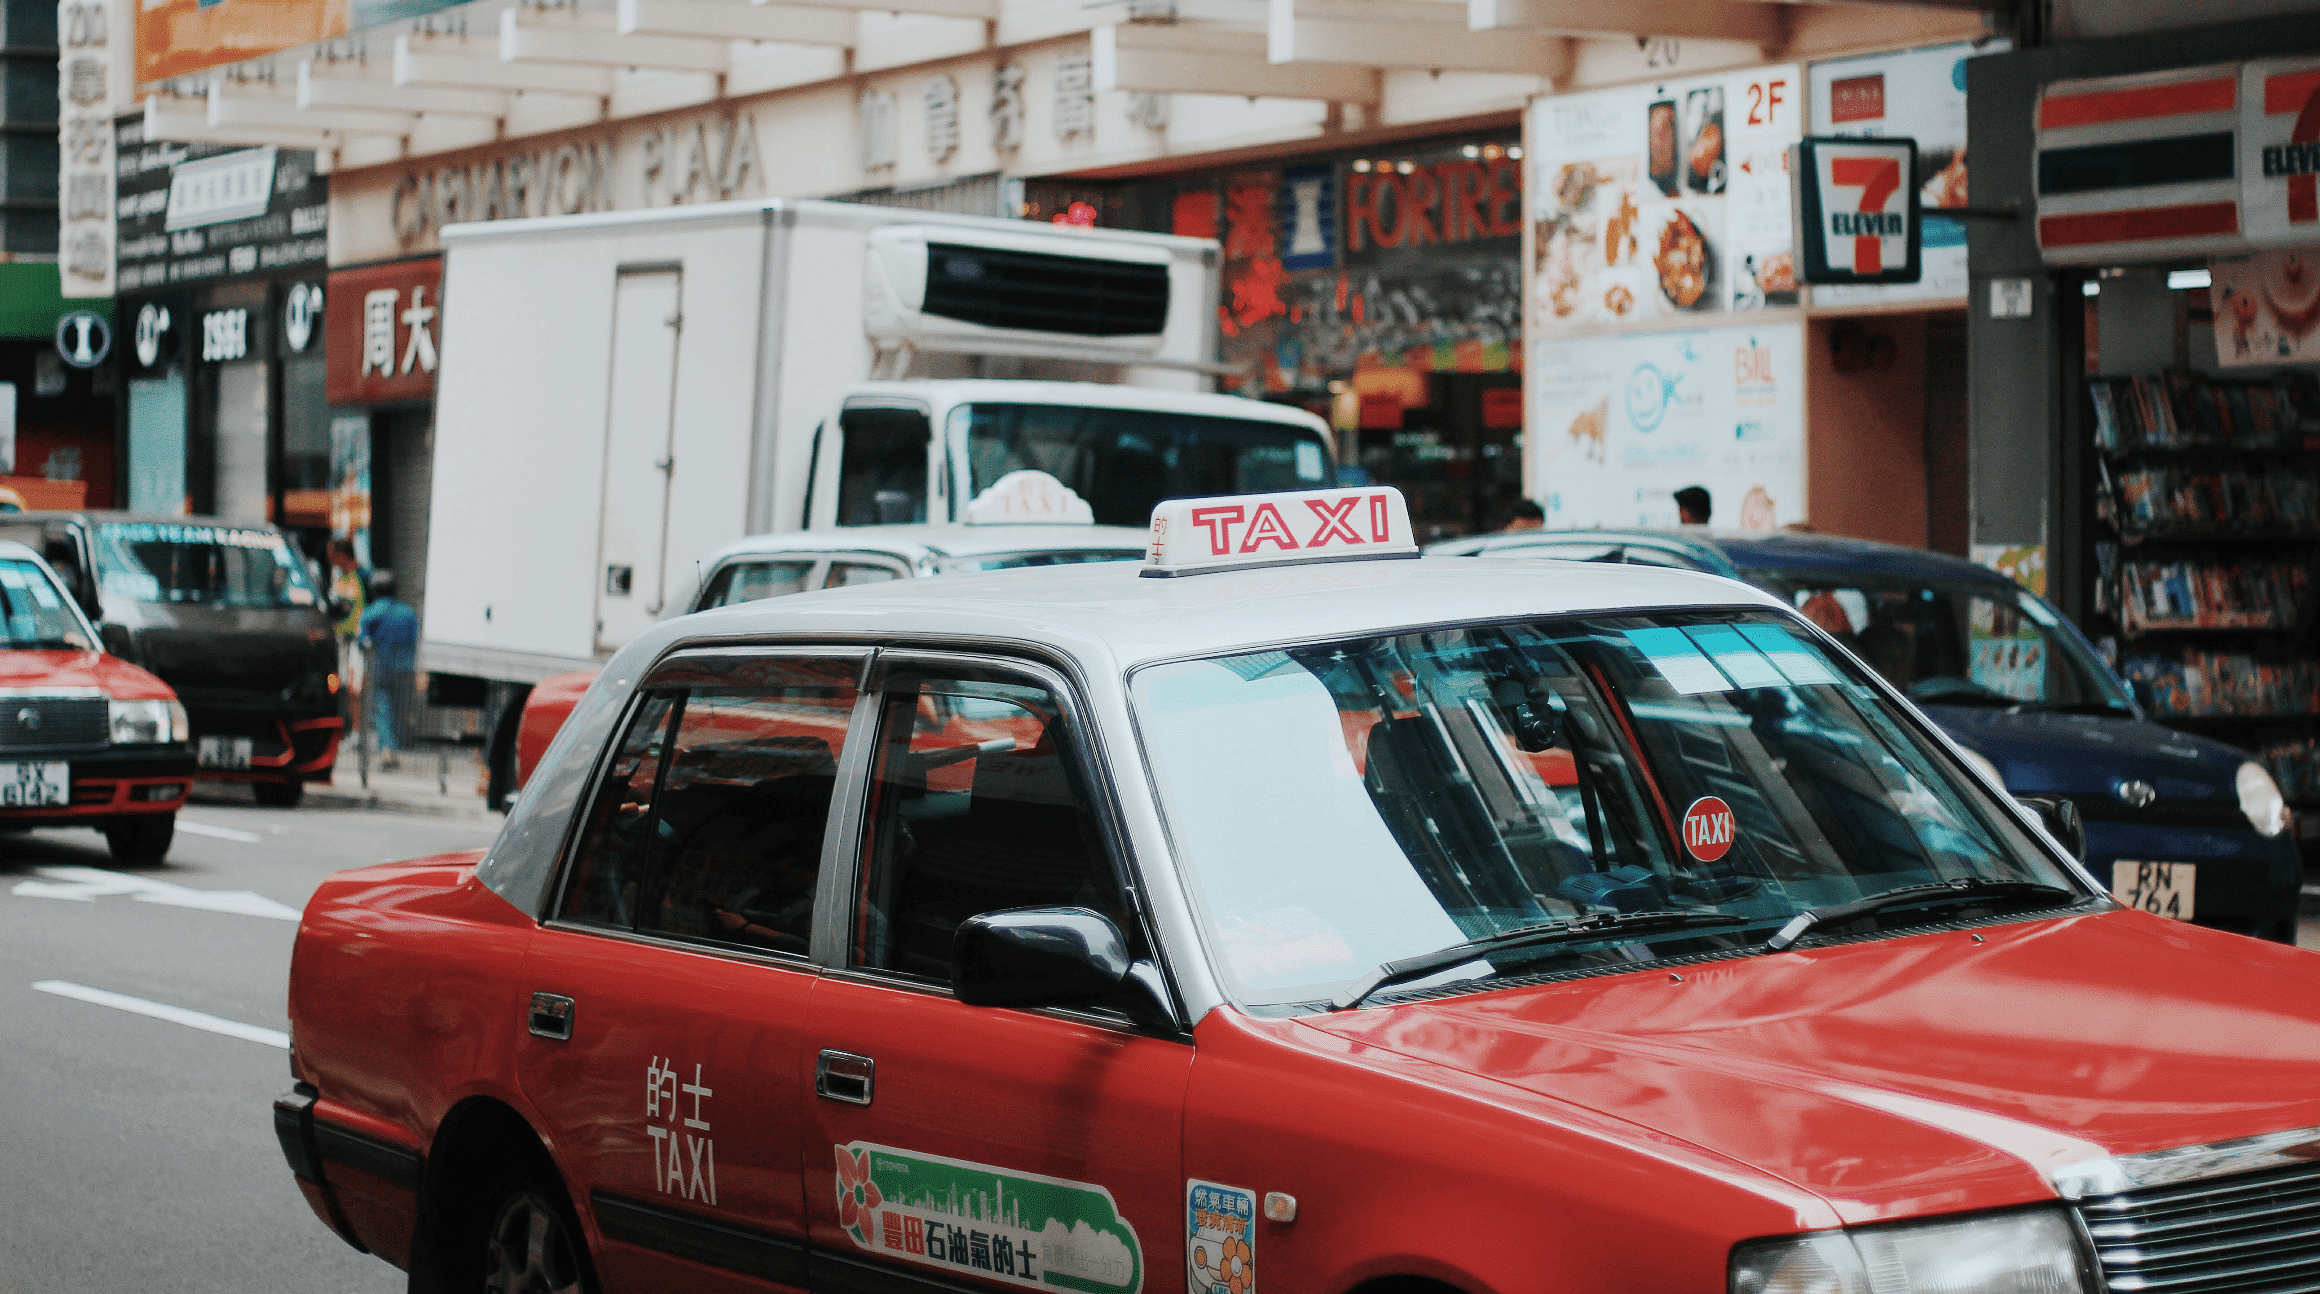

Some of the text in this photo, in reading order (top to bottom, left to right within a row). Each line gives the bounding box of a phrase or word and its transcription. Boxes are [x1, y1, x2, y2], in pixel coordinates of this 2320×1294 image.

[1746, 79, 1787, 126] 2F
[1347, 158, 1521, 252] FORTRE
[1831, 156, 1900, 274] 7
[1001, 494, 1068, 514] TAXI
[1191, 494, 1390, 555] TAXI
[1152, 515, 1167, 556] 的士
[1687, 812, 1730, 847] TAXI
[2138, 862, 2172, 889] RN
[2127, 890, 2181, 920] 764
[646, 1055, 713, 1131] 的士
[646, 1125, 717, 1206] TAXI
[882, 1210, 1038, 1281] 豐田石油氣的士
